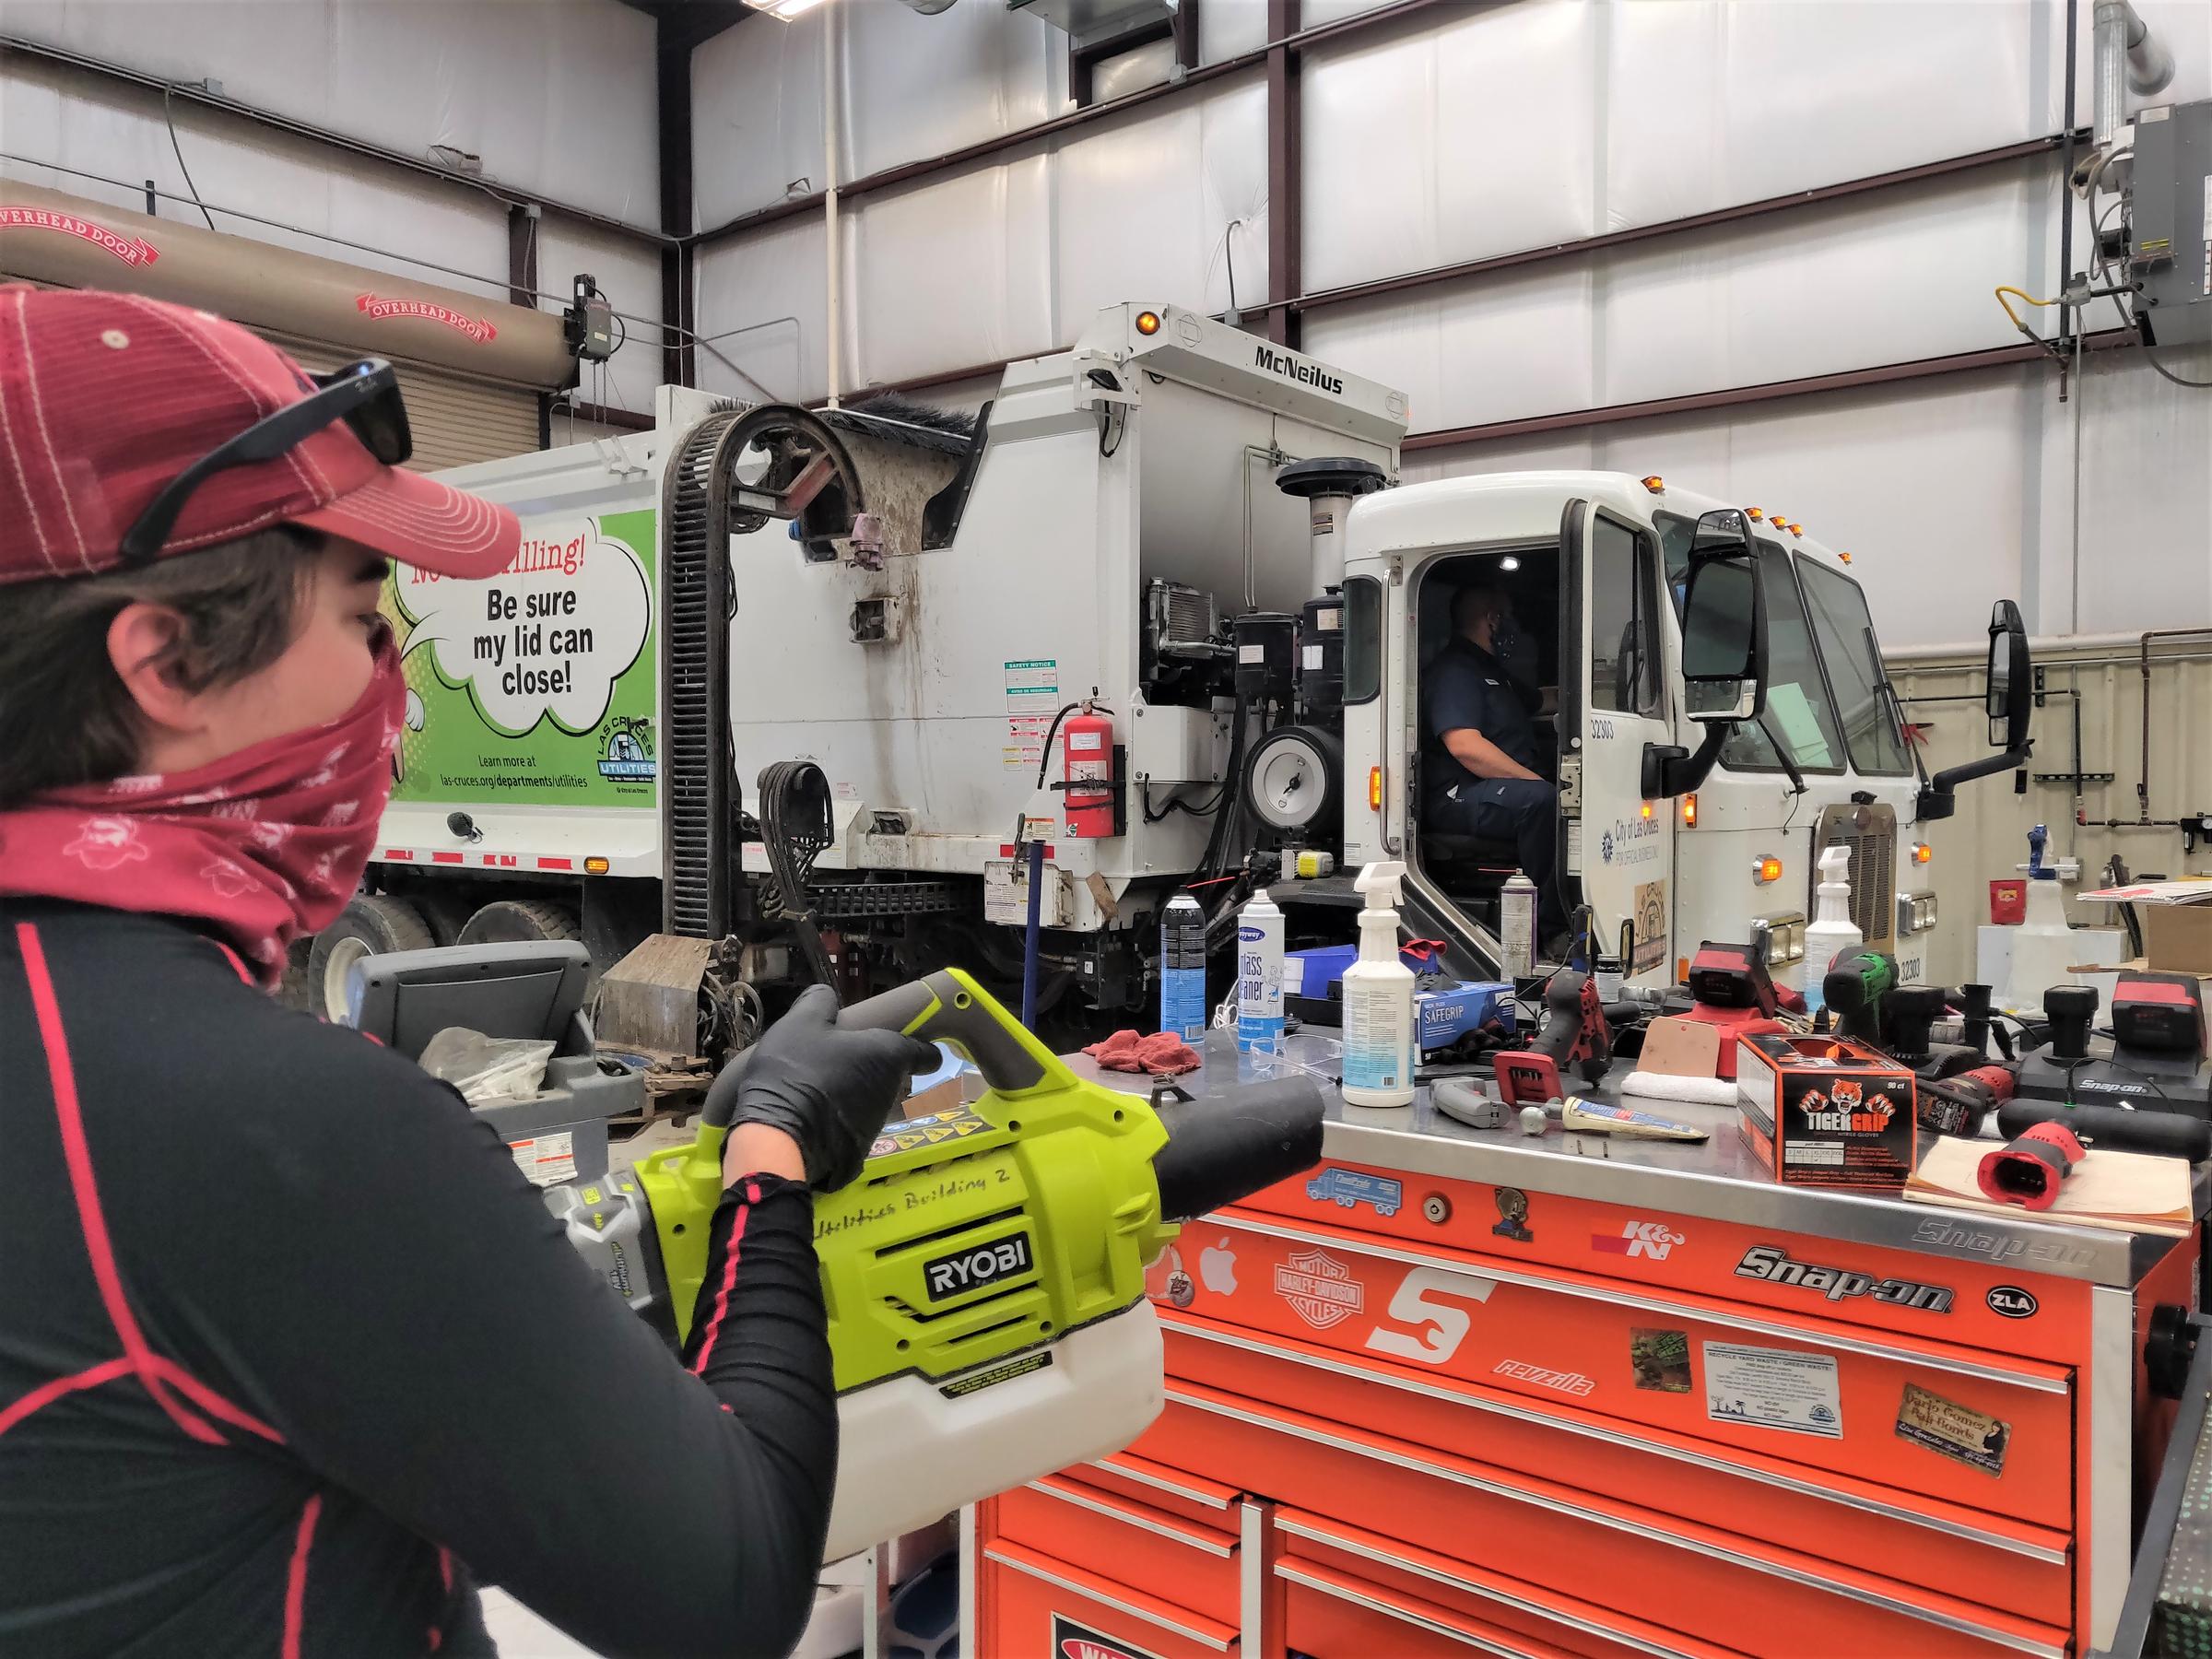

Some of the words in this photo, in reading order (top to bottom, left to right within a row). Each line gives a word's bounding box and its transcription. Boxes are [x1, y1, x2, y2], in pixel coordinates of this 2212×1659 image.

[0, 211, 88, 234] VERHEAD
[92, 230, 137, 264] DOOR
[372, 301, 446, 319] OVERHEAD
[449, 313, 483, 340] DOOR
[1255, 346, 1343, 394] McNeilus
[488, 589, 517, 620] Be
[525, 589, 576, 618] sure
[474, 634, 506, 666] my
[514, 624, 541, 656] lid
[549, 627, 593, 654] can
[502, 660, 571, 696] close!
[598, 724, 611, 755] LAS
[612, 716, 653, 756] CRCES
[1591, 719, 1614, 739] 32303
[478, 755, 501, 768] Learn
[503, 757, 525, 768] more
[526, 755, 536, 767] at
[600, 764, 655, 774] UTILITIES
[441, 773, 588, 790] las-cruces.org/departments/utilities
[1616, 818, 1626, 846] City
[1628, 818, 1632, 840] of
[1634, 817, 1642, 838] Las
[1241, 953, 1262, 979] glass
[1901, 958, 1920, 982] 32303
[1239, 981, 1264, 1001] eaner
[1425, 1006, 1464, 1024] SAFEGRIP
[2079, 1079, 2143, 1092] Snap-on
[905, 1179, 986, 1208] Building
[995, 1169, 1010, 1182] 2
[1912, 1218, 2099, 1268] Snap-on
[929, 1240, 1026, 1292] RYOBI
[1295, 1257, 1343, 1279] MOTOR
[1734, 1245, 1955, 1314] Snap-on
[1991, 1293, 2031, 1311] ZLA
[1493, 1359, 1595, 1396] revzilla
